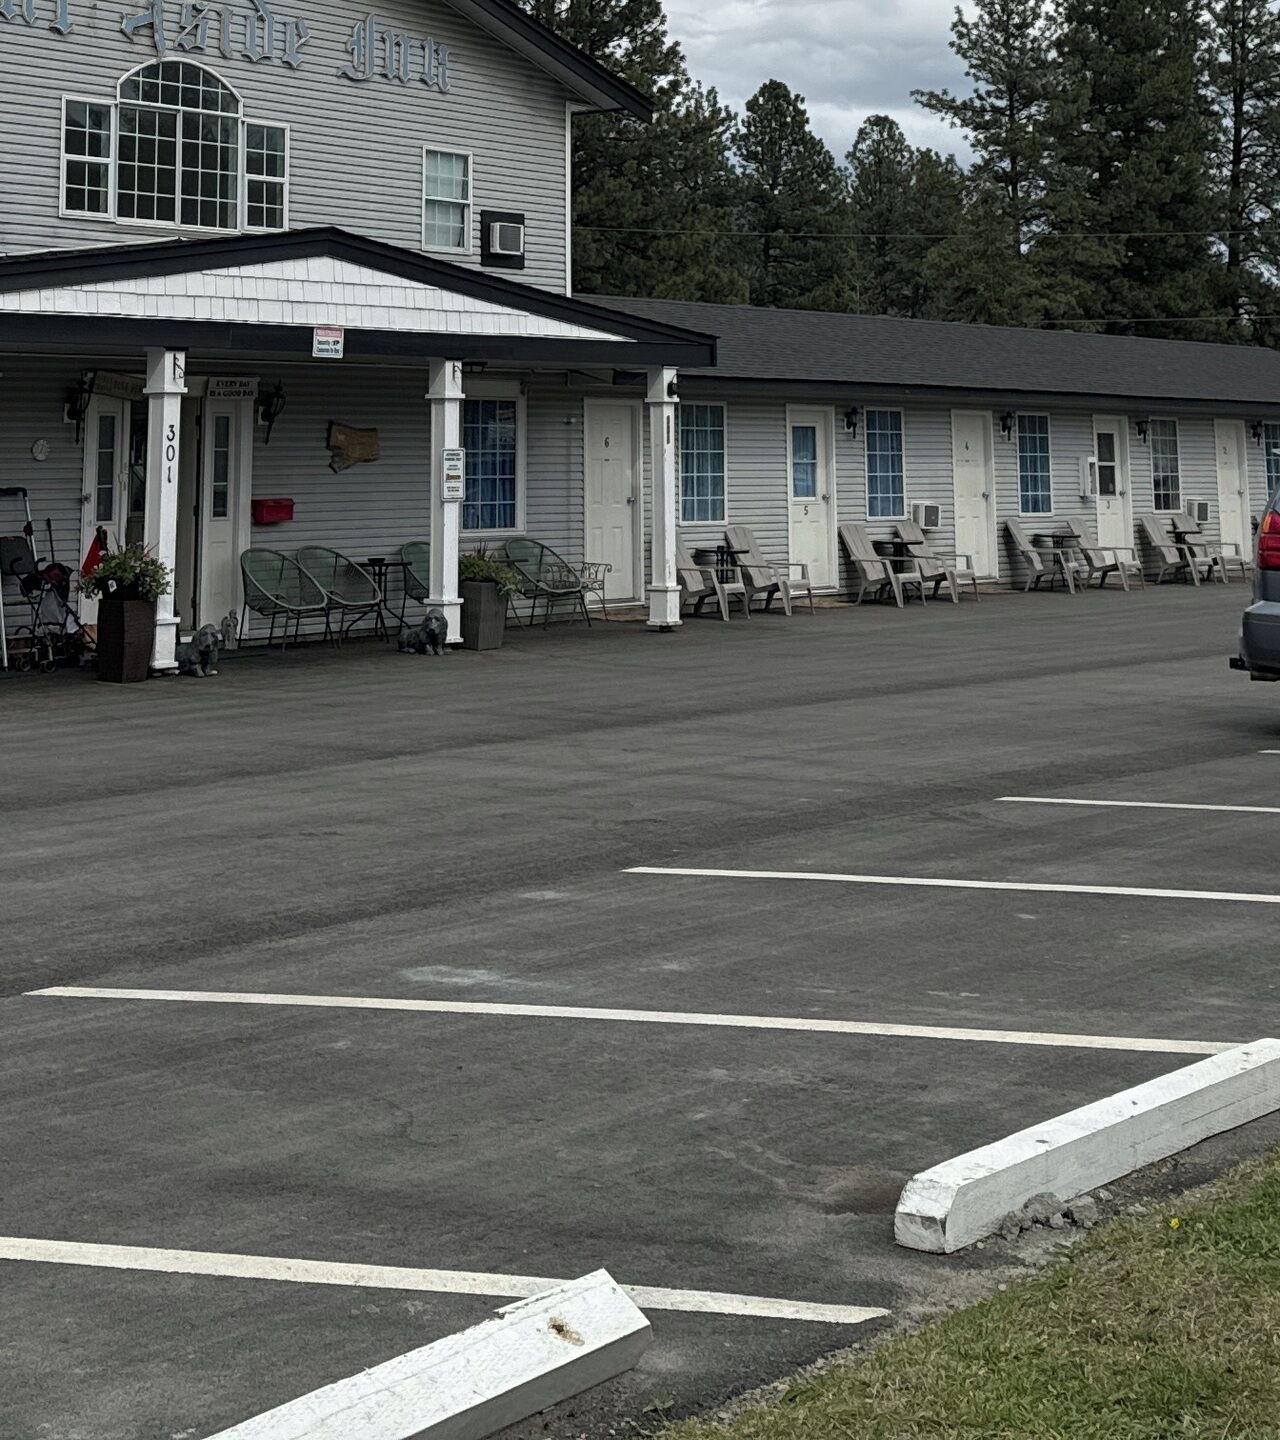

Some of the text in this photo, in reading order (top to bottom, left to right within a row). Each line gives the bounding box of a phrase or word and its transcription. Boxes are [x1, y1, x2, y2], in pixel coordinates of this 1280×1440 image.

[336, 12, 452, 93] Inn
[166, 424, 176, 484] 301
[604, 436, 610, 448] 6
[803, 505, 809, 516] 5
